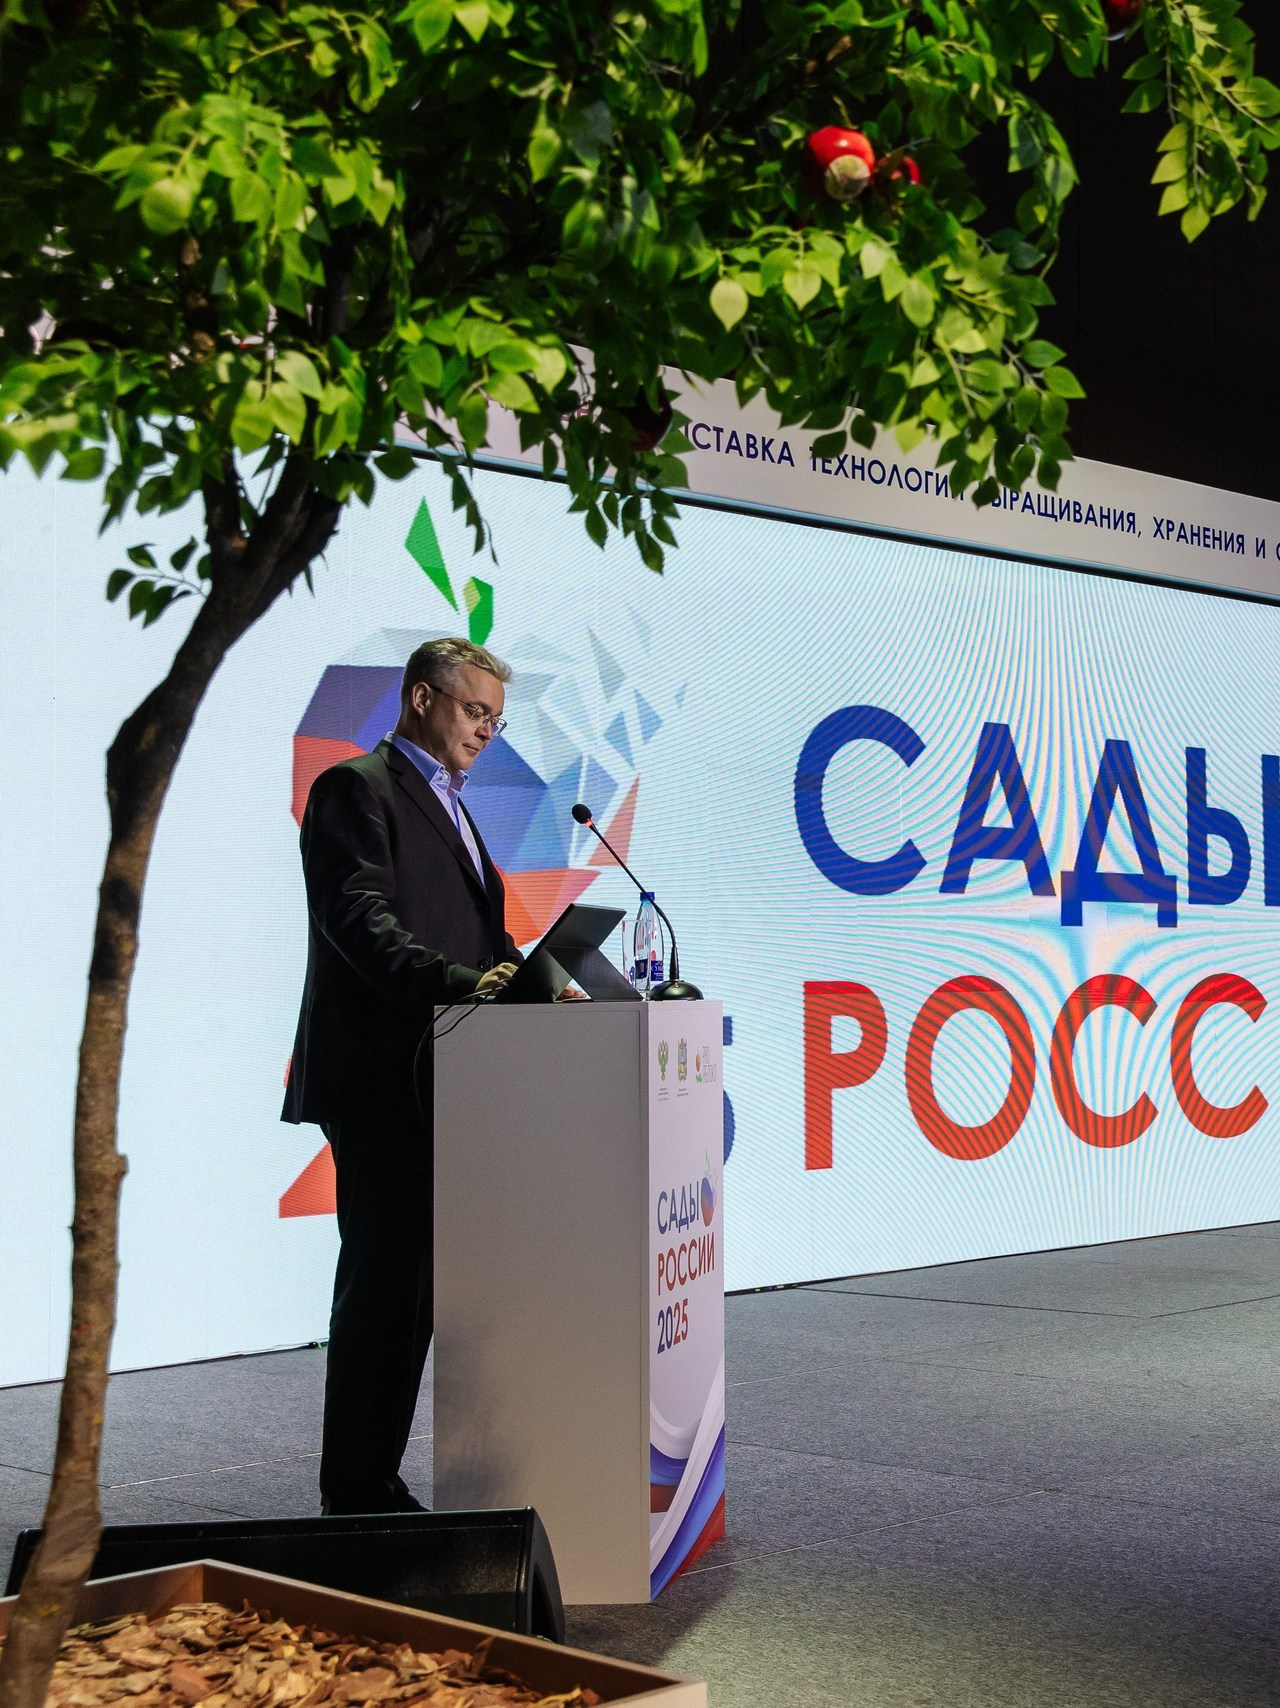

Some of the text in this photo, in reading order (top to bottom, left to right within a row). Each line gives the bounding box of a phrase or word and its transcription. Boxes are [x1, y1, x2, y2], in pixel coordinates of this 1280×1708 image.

[684, 422, 796, 468] СТАВКА
[978, 482, 1142, 538] ЫРАЩИВАНИЯ,
[1153, 516, 1245, 555] ХРАНЕНИЯ
[1255, 537, 1266, 559] И
[657, 1181, 700, 1235] САДЫ
[658, 1232, 716, 1297] РОССИИ
[657, 1298, 689, 1355] 2025
